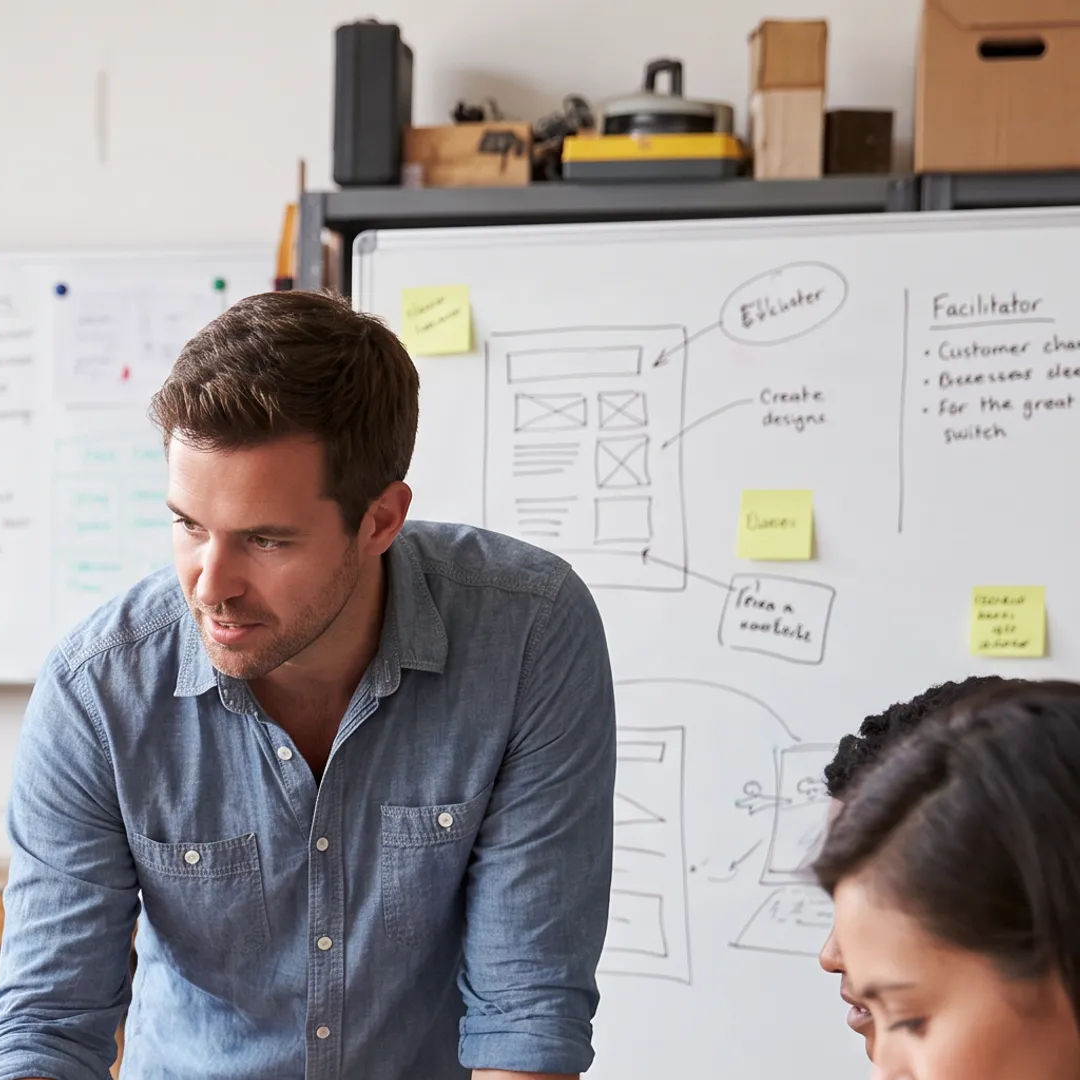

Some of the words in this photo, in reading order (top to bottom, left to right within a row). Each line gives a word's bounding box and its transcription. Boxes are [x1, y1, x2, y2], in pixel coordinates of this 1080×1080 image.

[933, 292, 1044, 320] Facilitator
[938, 339, 1030, 361] Customer
[759, 384, 825, 405] Create
[980, 395, 1013, 413] the
[1022, 393, 1075, 420] great
[762, 411, 826, 433] designs
[944, 422, 1008, 444] switch
